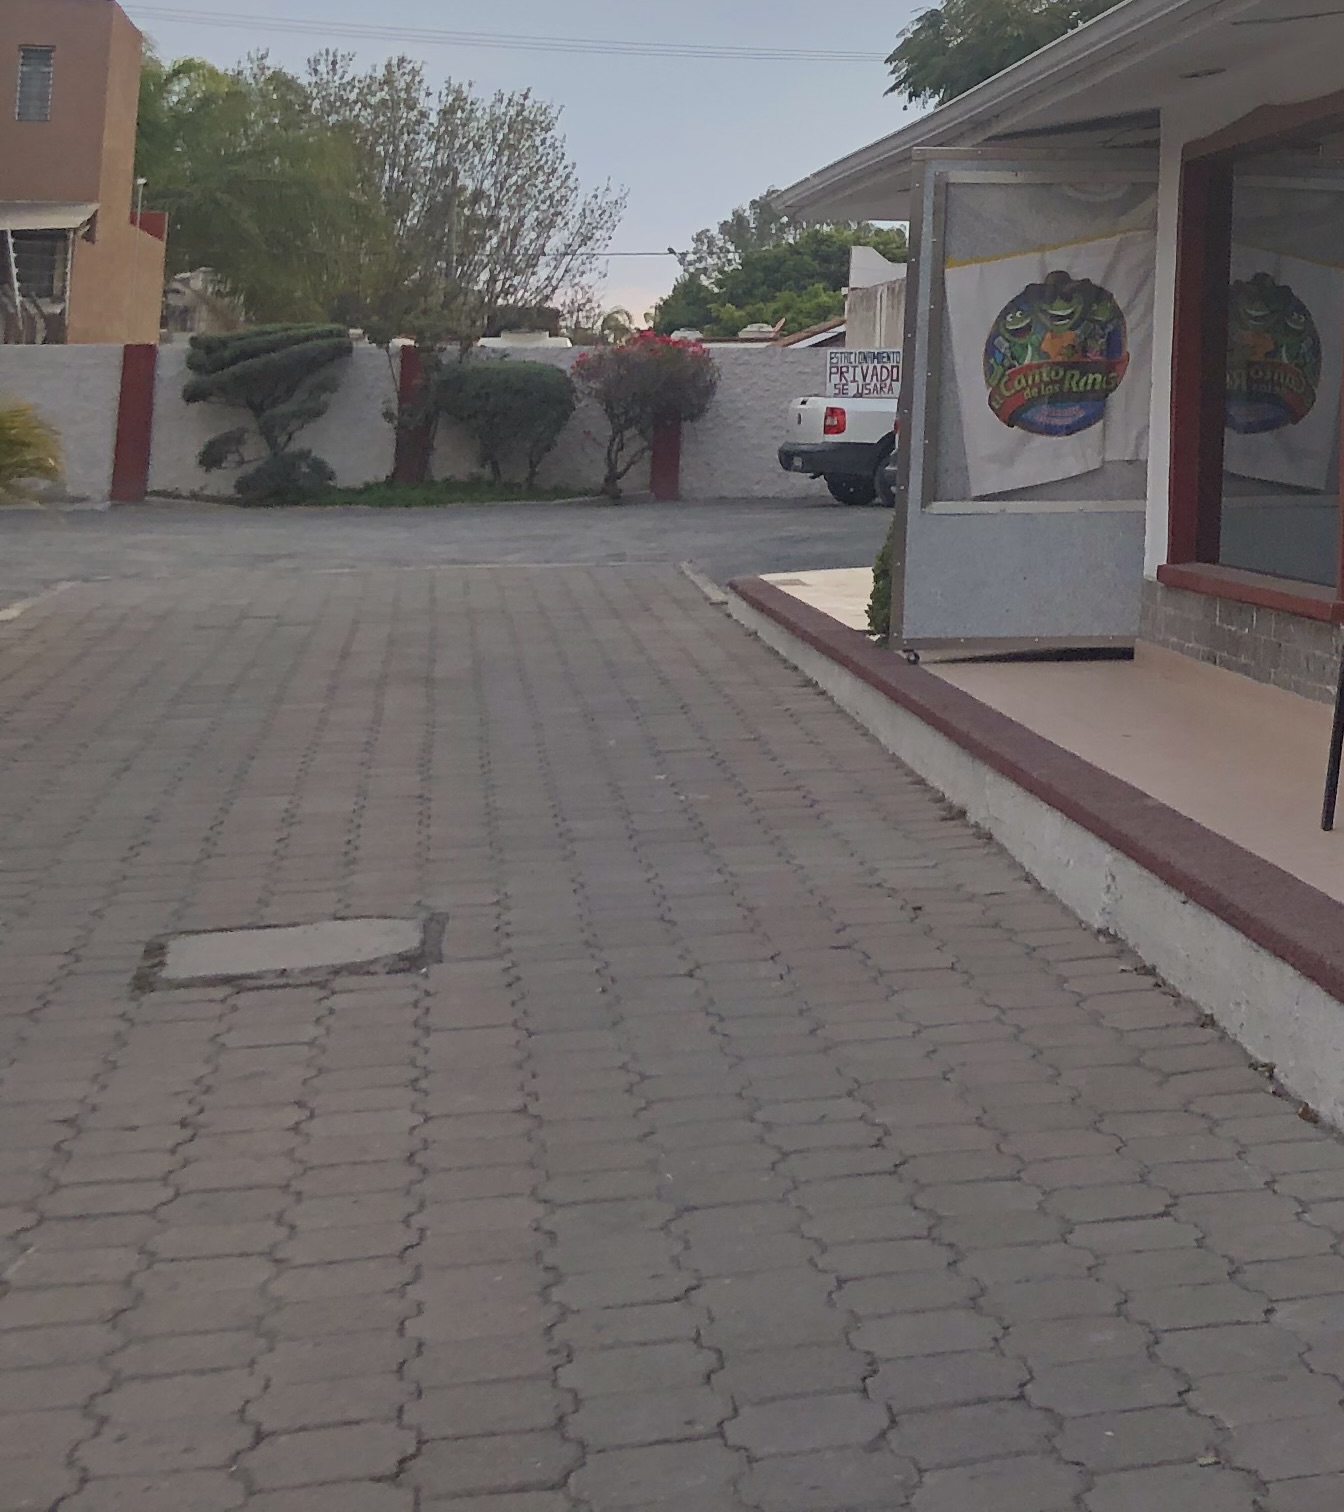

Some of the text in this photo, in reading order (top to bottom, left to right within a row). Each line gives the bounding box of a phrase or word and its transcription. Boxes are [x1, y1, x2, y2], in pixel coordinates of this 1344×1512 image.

[828, 365, 900, 383] PRIVADO
[834, 382, 894, 396] SE USARA
